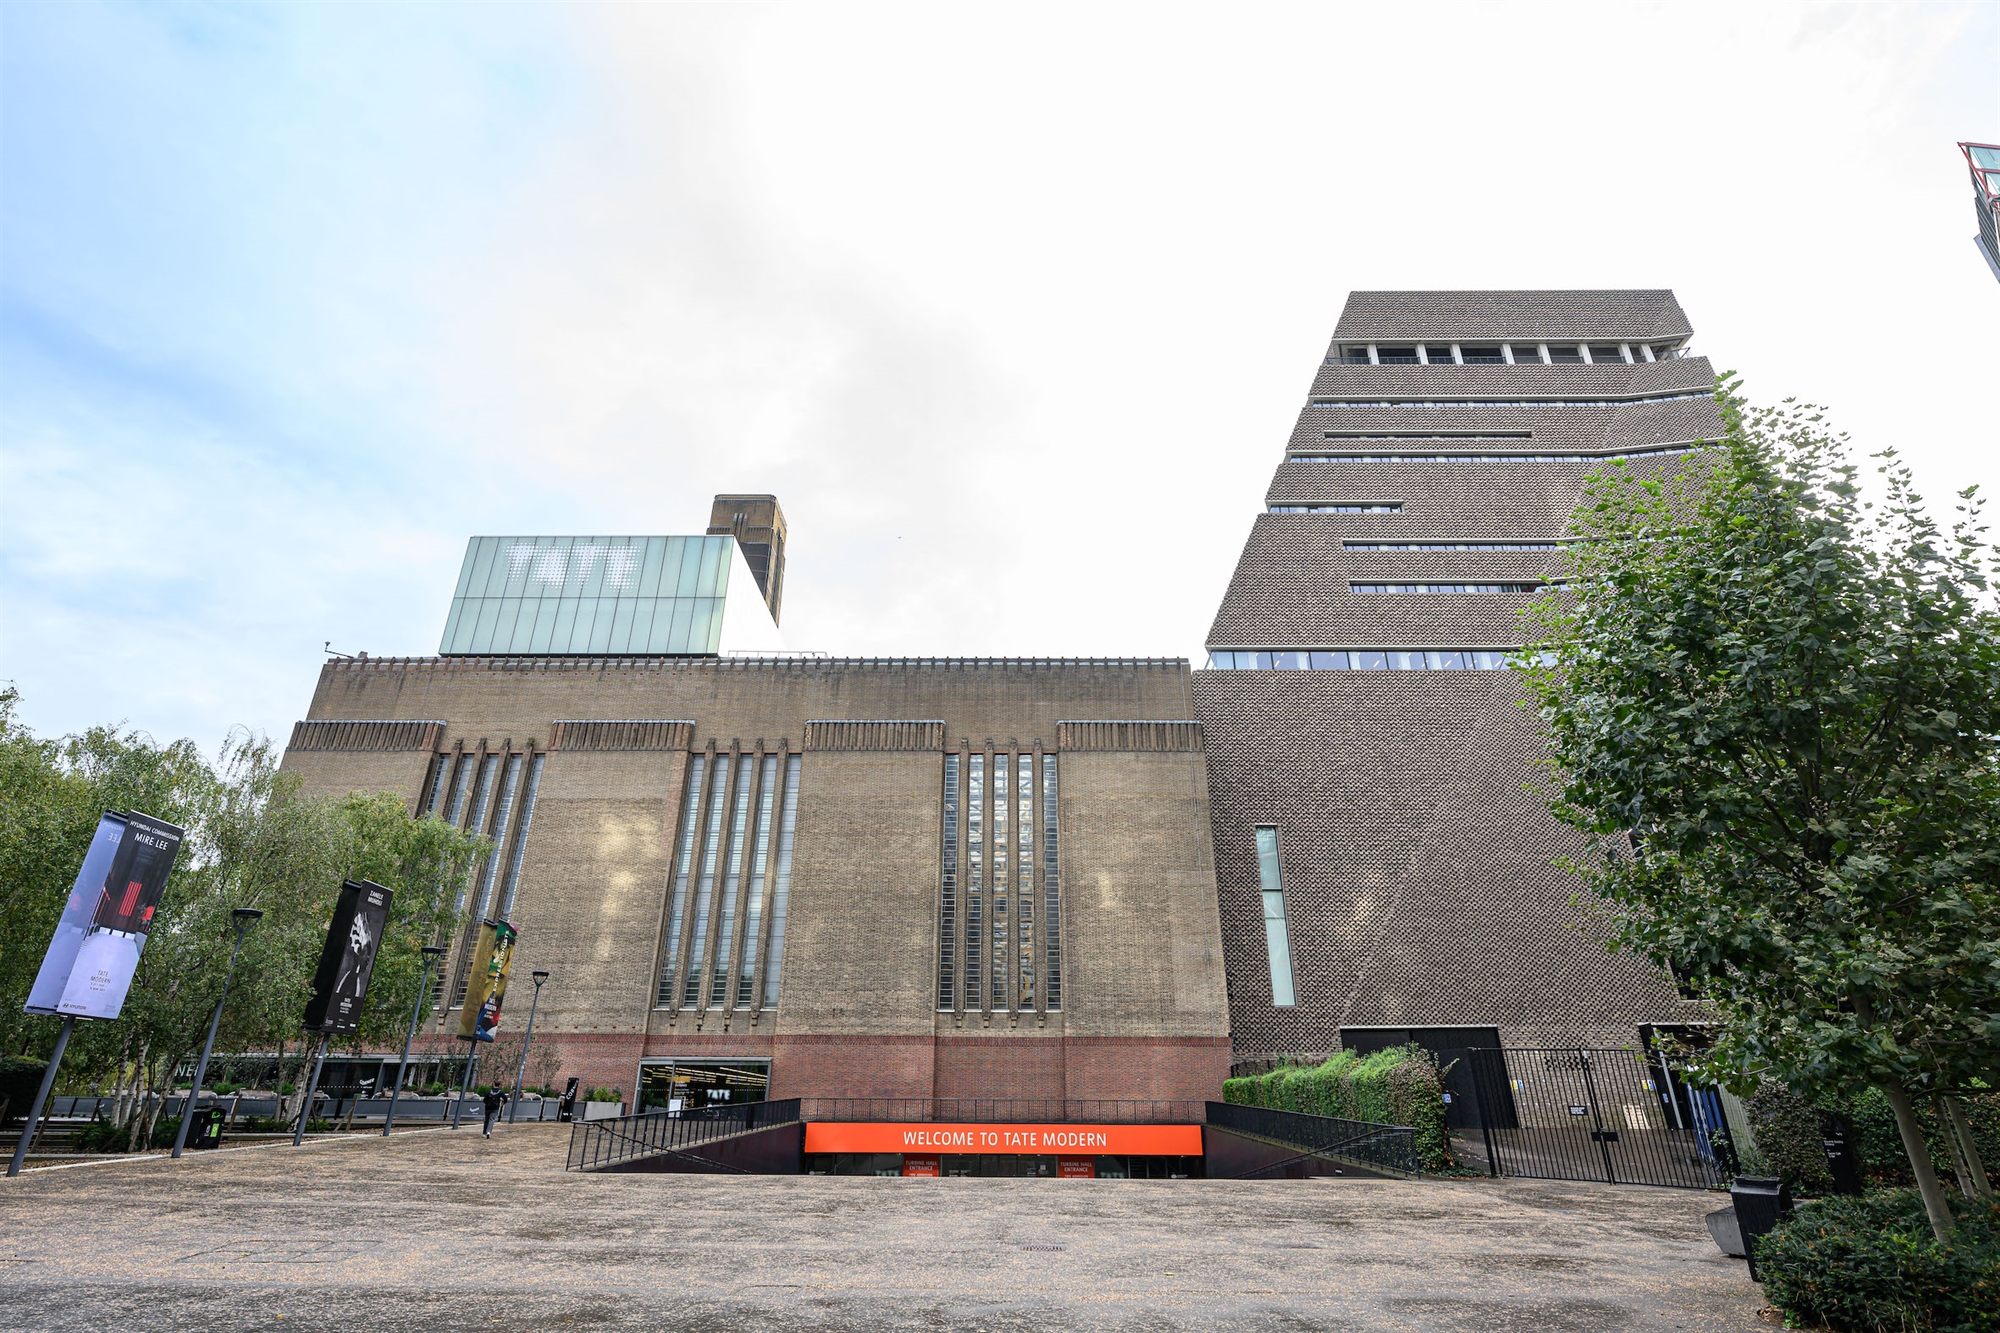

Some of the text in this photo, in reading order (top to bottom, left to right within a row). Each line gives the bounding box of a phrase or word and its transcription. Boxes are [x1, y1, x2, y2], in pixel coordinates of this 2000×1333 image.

[502, 542, 642, 592] TATE
[129, 820, 151, 832] HYUNDAI
[151, 827, 180, 842] COMMISSION
[134, 832, 168, 851] MIRE LEE
[90, 976, 111, 984] MODERN
[706, 1088, 731, 1100] TATE
[903, 1131, 1107, 1147] WELCOME TO TATE MODERN
